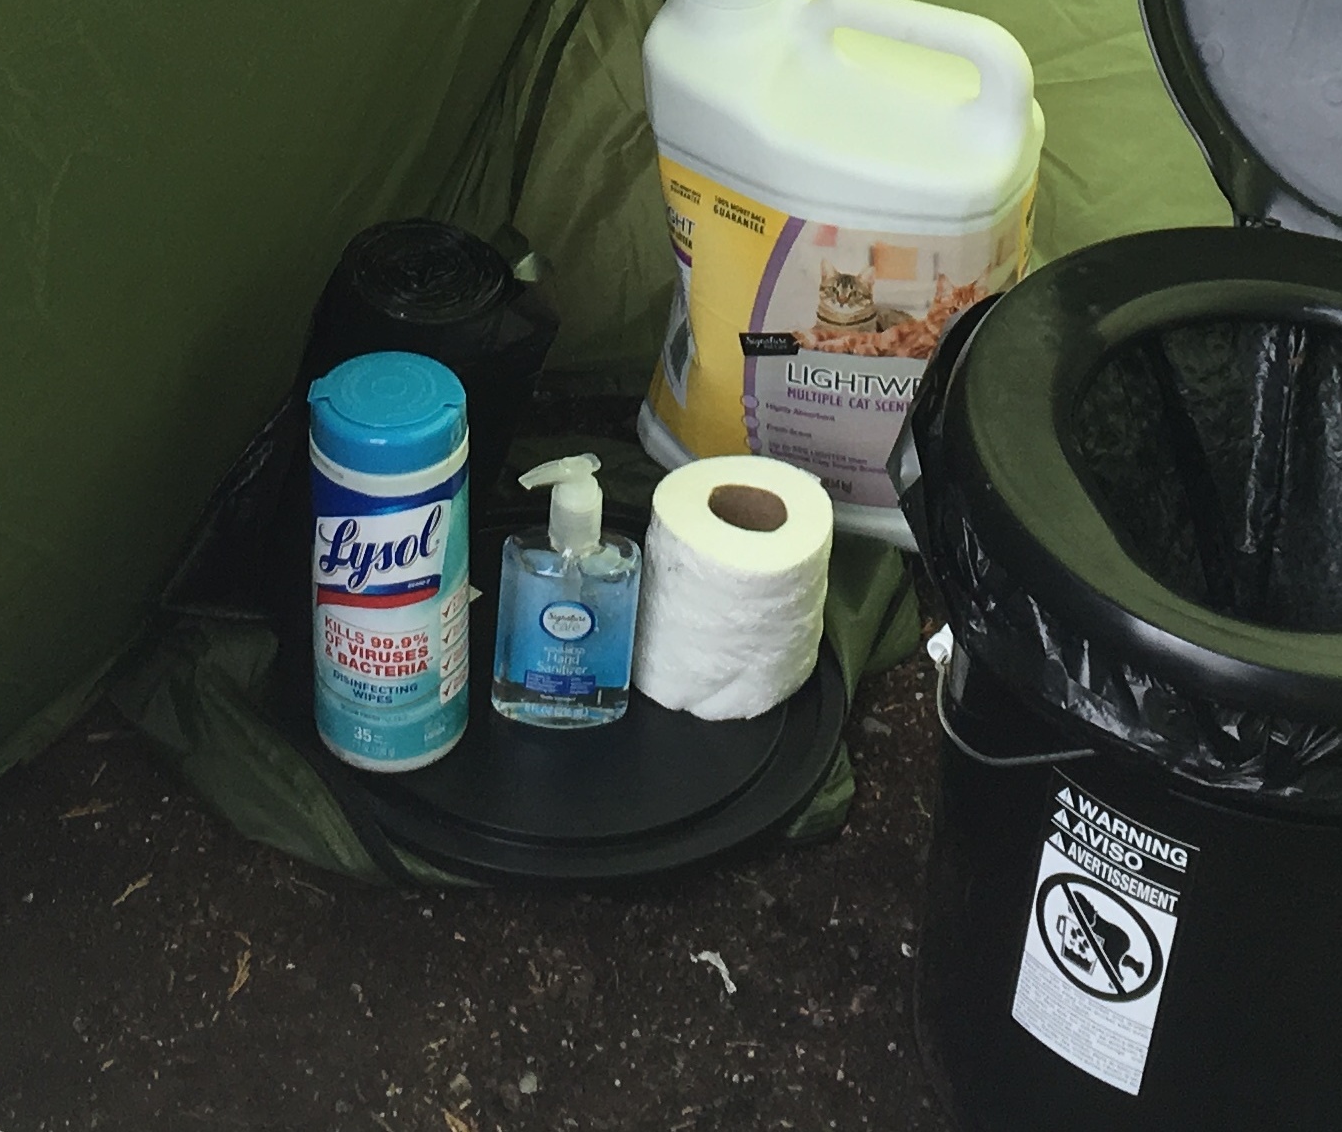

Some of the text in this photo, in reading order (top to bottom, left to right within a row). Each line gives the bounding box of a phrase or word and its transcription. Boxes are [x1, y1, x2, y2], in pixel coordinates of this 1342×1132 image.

[713, 204, 765, 235] GUARANTEE
[787, 387, 842, 407] MULTIPLE
[848, 397, 871, 411] CAT
[318, 504, 442, 590] Lysol
[325, 615, 429, 650] KILLS 99.9%
[325, 630, 429, 664] OF VIRUSES
[325, 643, 334, 658] &
[332, 669, 419, 695] DISINFECTING
[352, 688, 393, 704] WIPES
[353, 726, 372, 743] 35
[1072, 819, 1144, 871] AVISO
[1078, 794, 1189, 868] WARNING
[1067, 842, 1179, 913] AVERTISSEMENT
